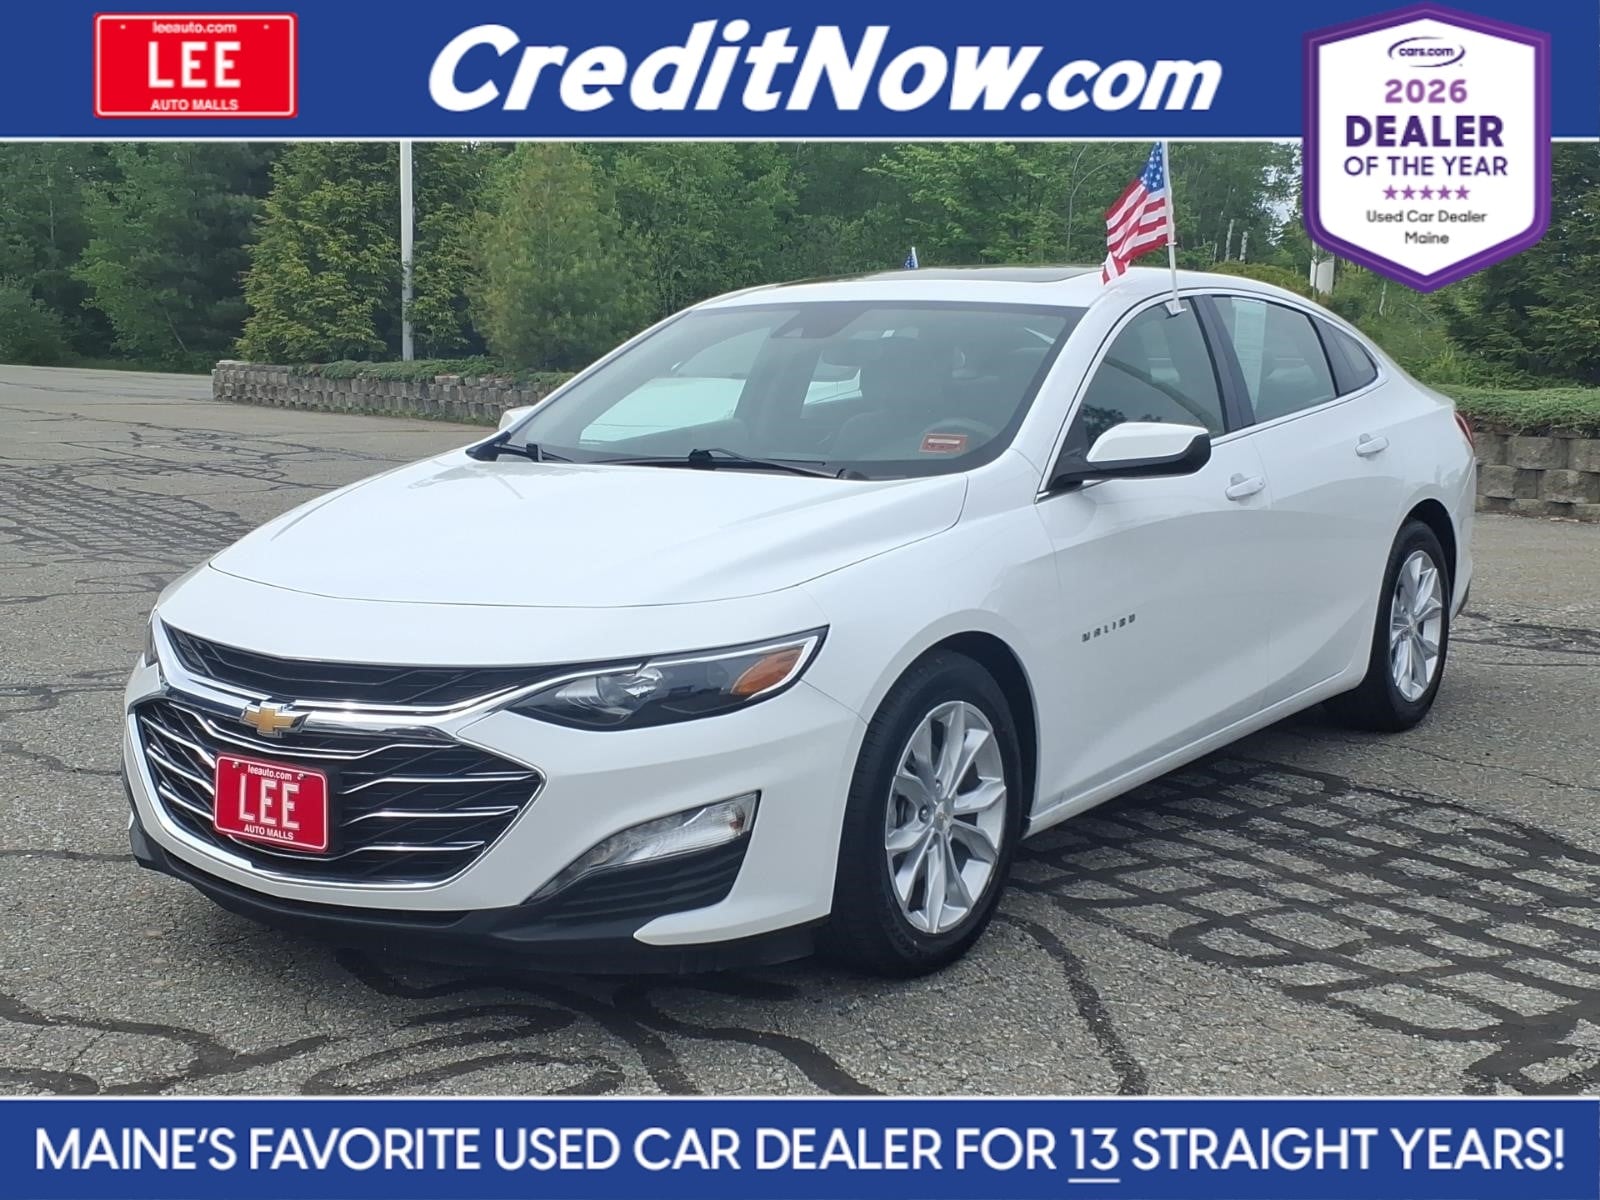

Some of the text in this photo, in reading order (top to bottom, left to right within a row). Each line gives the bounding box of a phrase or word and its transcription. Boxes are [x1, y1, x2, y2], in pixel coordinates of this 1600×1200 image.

[1082, 613, 1136, 642] MALIBU
[247, 764, 292, 781] leeauto.com
[238, 773, 300, 830] LEE
[244, 824, 294, 841] AUTO MALLS
